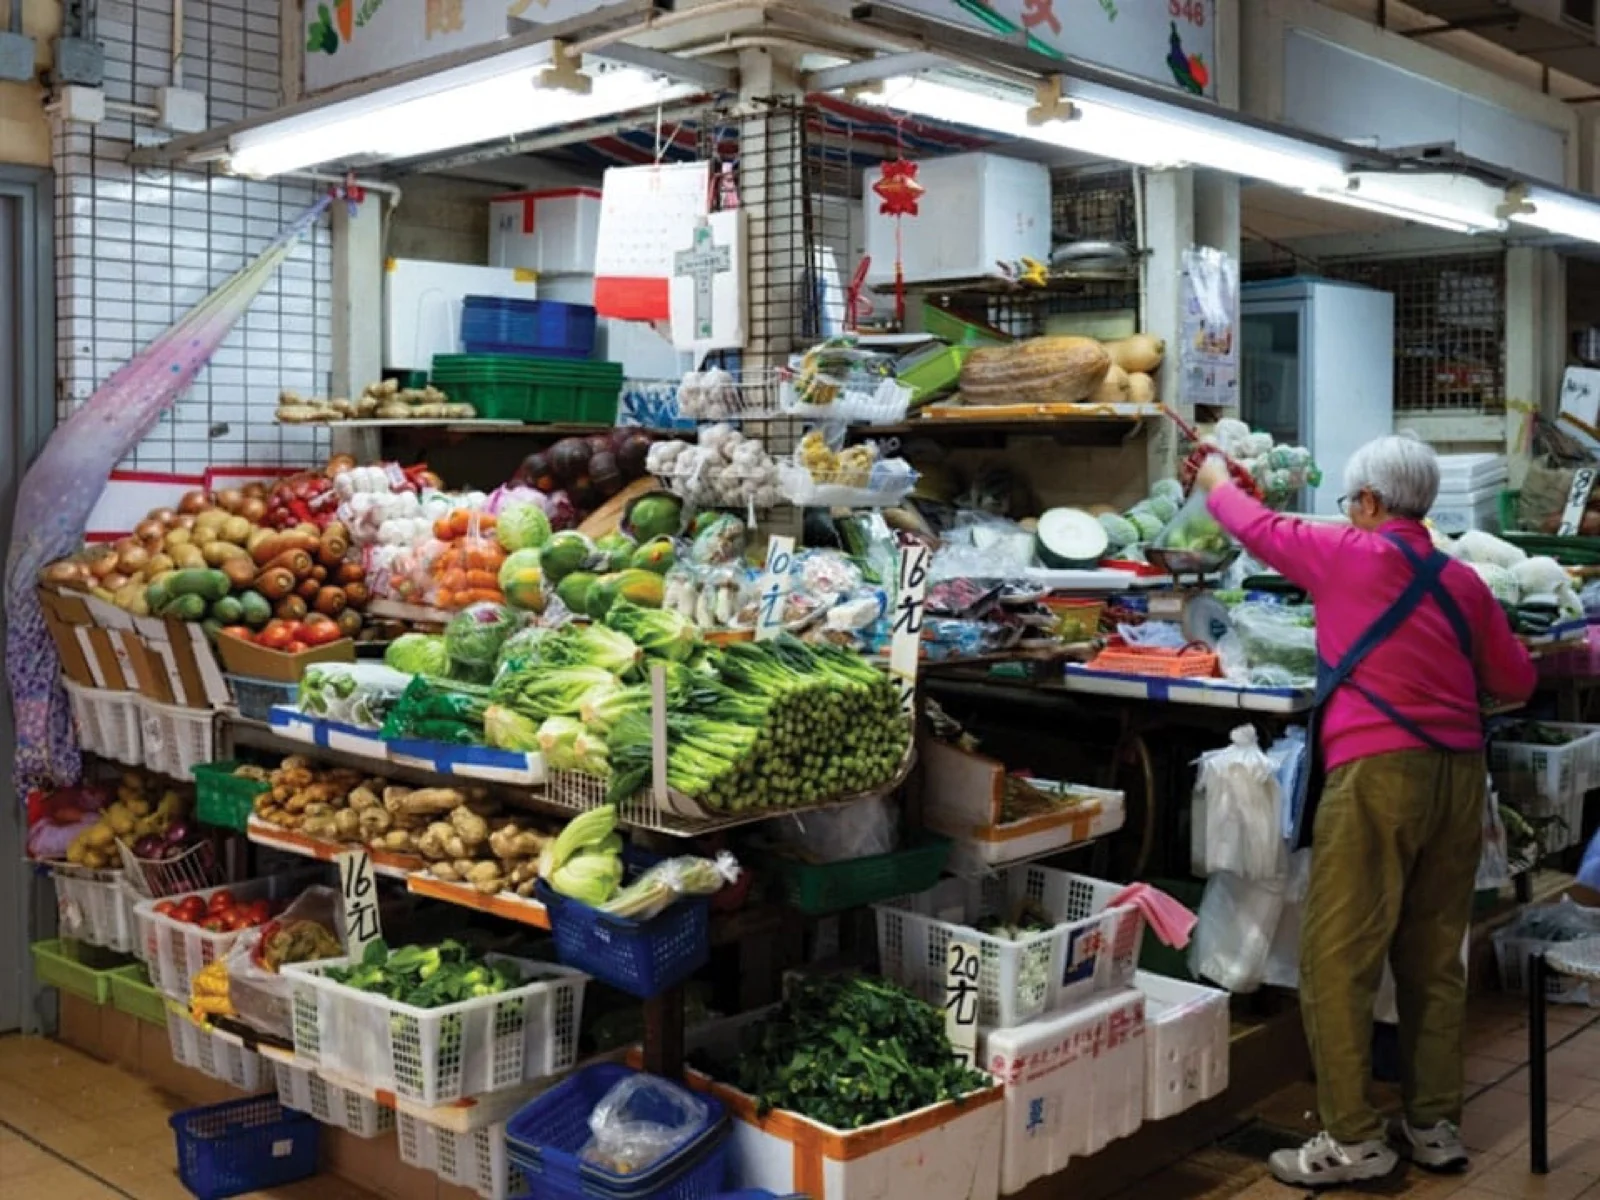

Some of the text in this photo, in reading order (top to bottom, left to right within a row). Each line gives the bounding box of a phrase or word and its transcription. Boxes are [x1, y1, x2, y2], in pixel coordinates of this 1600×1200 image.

[893, 548, 925, 633] 16元
[346, 852, 378, 941] 16元
[946, 945, 979, 1025] 20元
